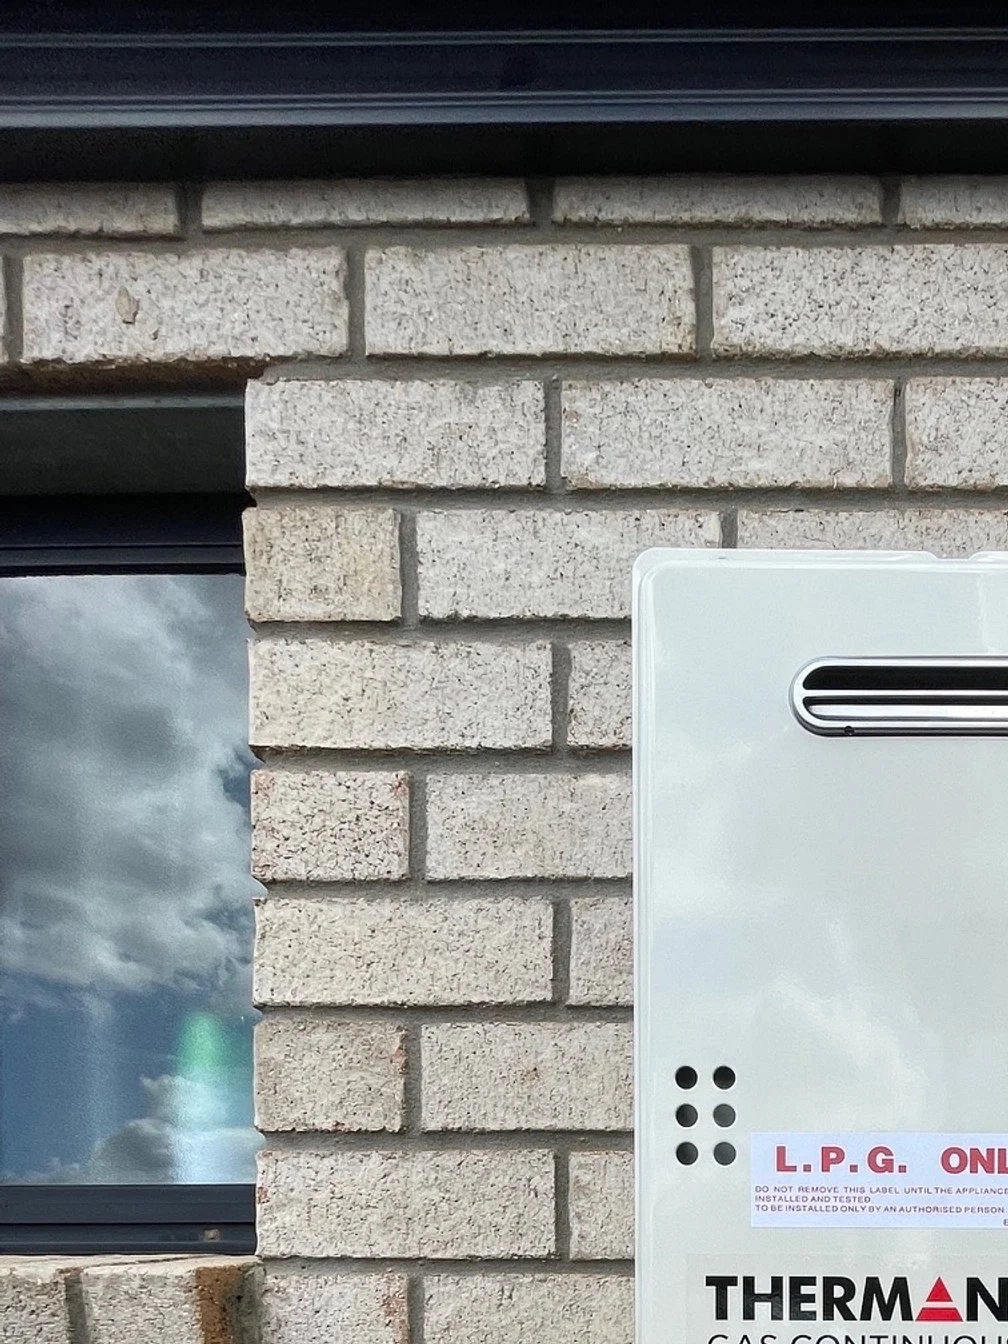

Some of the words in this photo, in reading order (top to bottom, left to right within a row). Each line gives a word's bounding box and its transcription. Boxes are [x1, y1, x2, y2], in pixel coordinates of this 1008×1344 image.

[776, 1145, 907, 1173] L.P.G.
[755, 1185, 769, 1193] DO
[798, 1186, 840, 1194] REMOVE
[843, 1186, 866, 1194] THIS
[755, 1195, 808, 1203] INSTALLED
[755, 1204, 768, 1212] TO
[840, 1205, 867, 1213] ONLY
